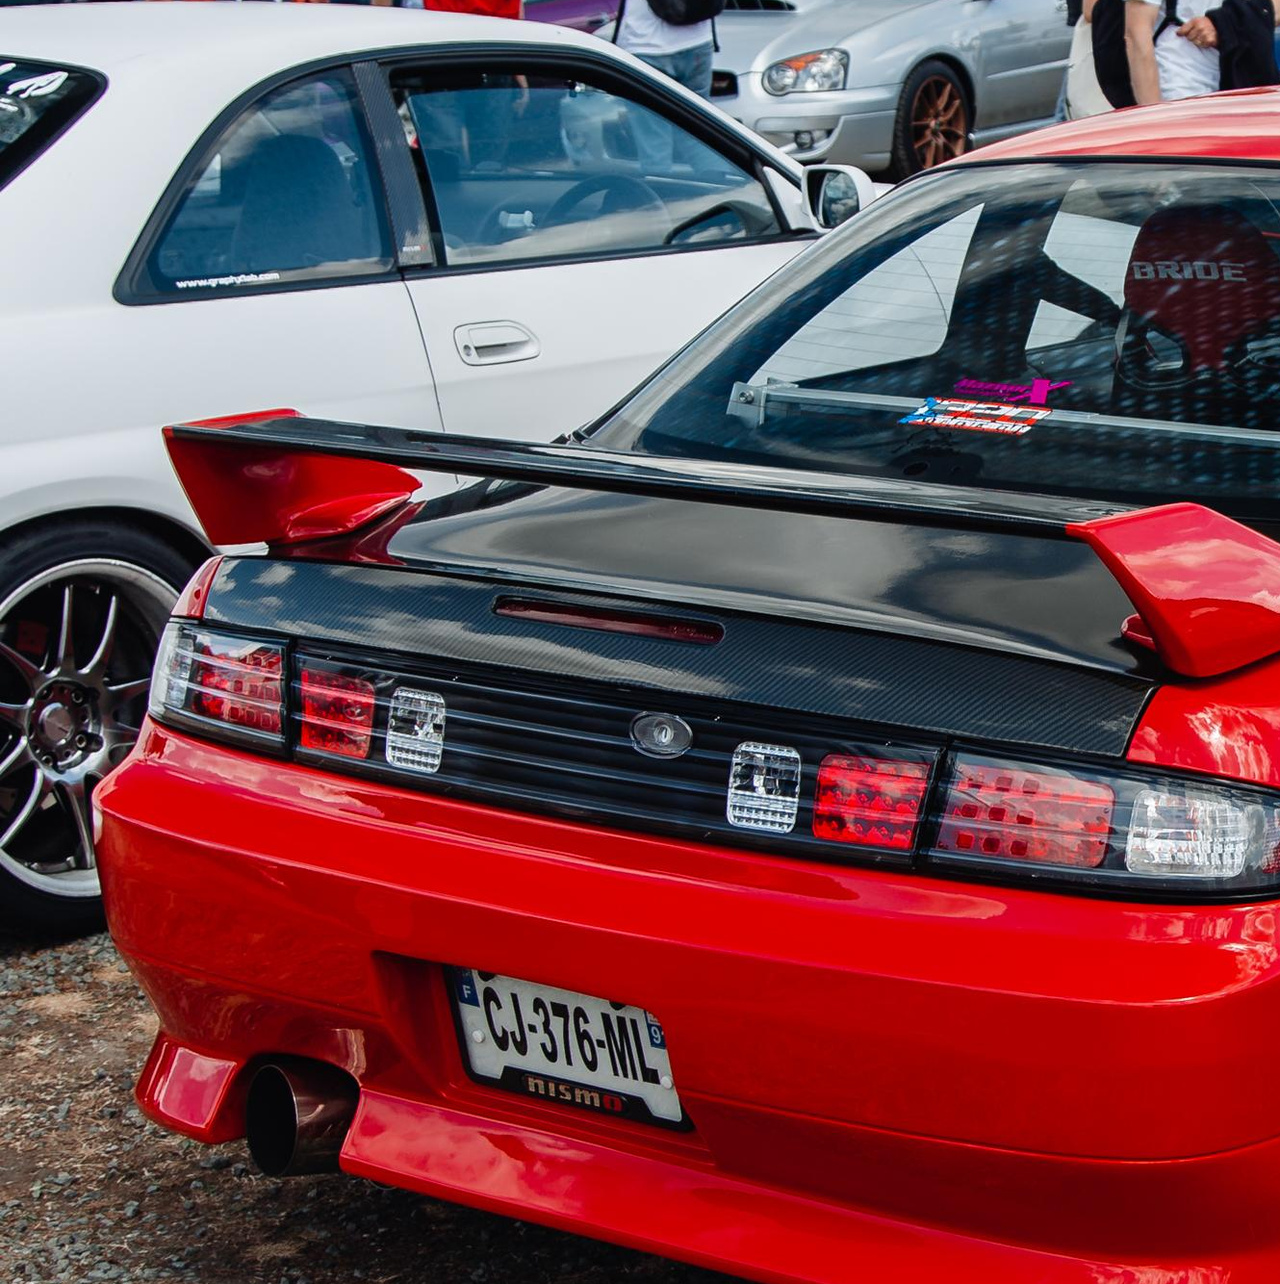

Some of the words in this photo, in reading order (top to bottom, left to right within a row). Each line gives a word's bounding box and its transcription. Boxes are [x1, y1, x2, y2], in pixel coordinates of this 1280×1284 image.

[1131, 260, 1248, 282] BRIDE
[462, 984, 472, 999] F
[482, 986, 661, 1085] CJ-376-ML
